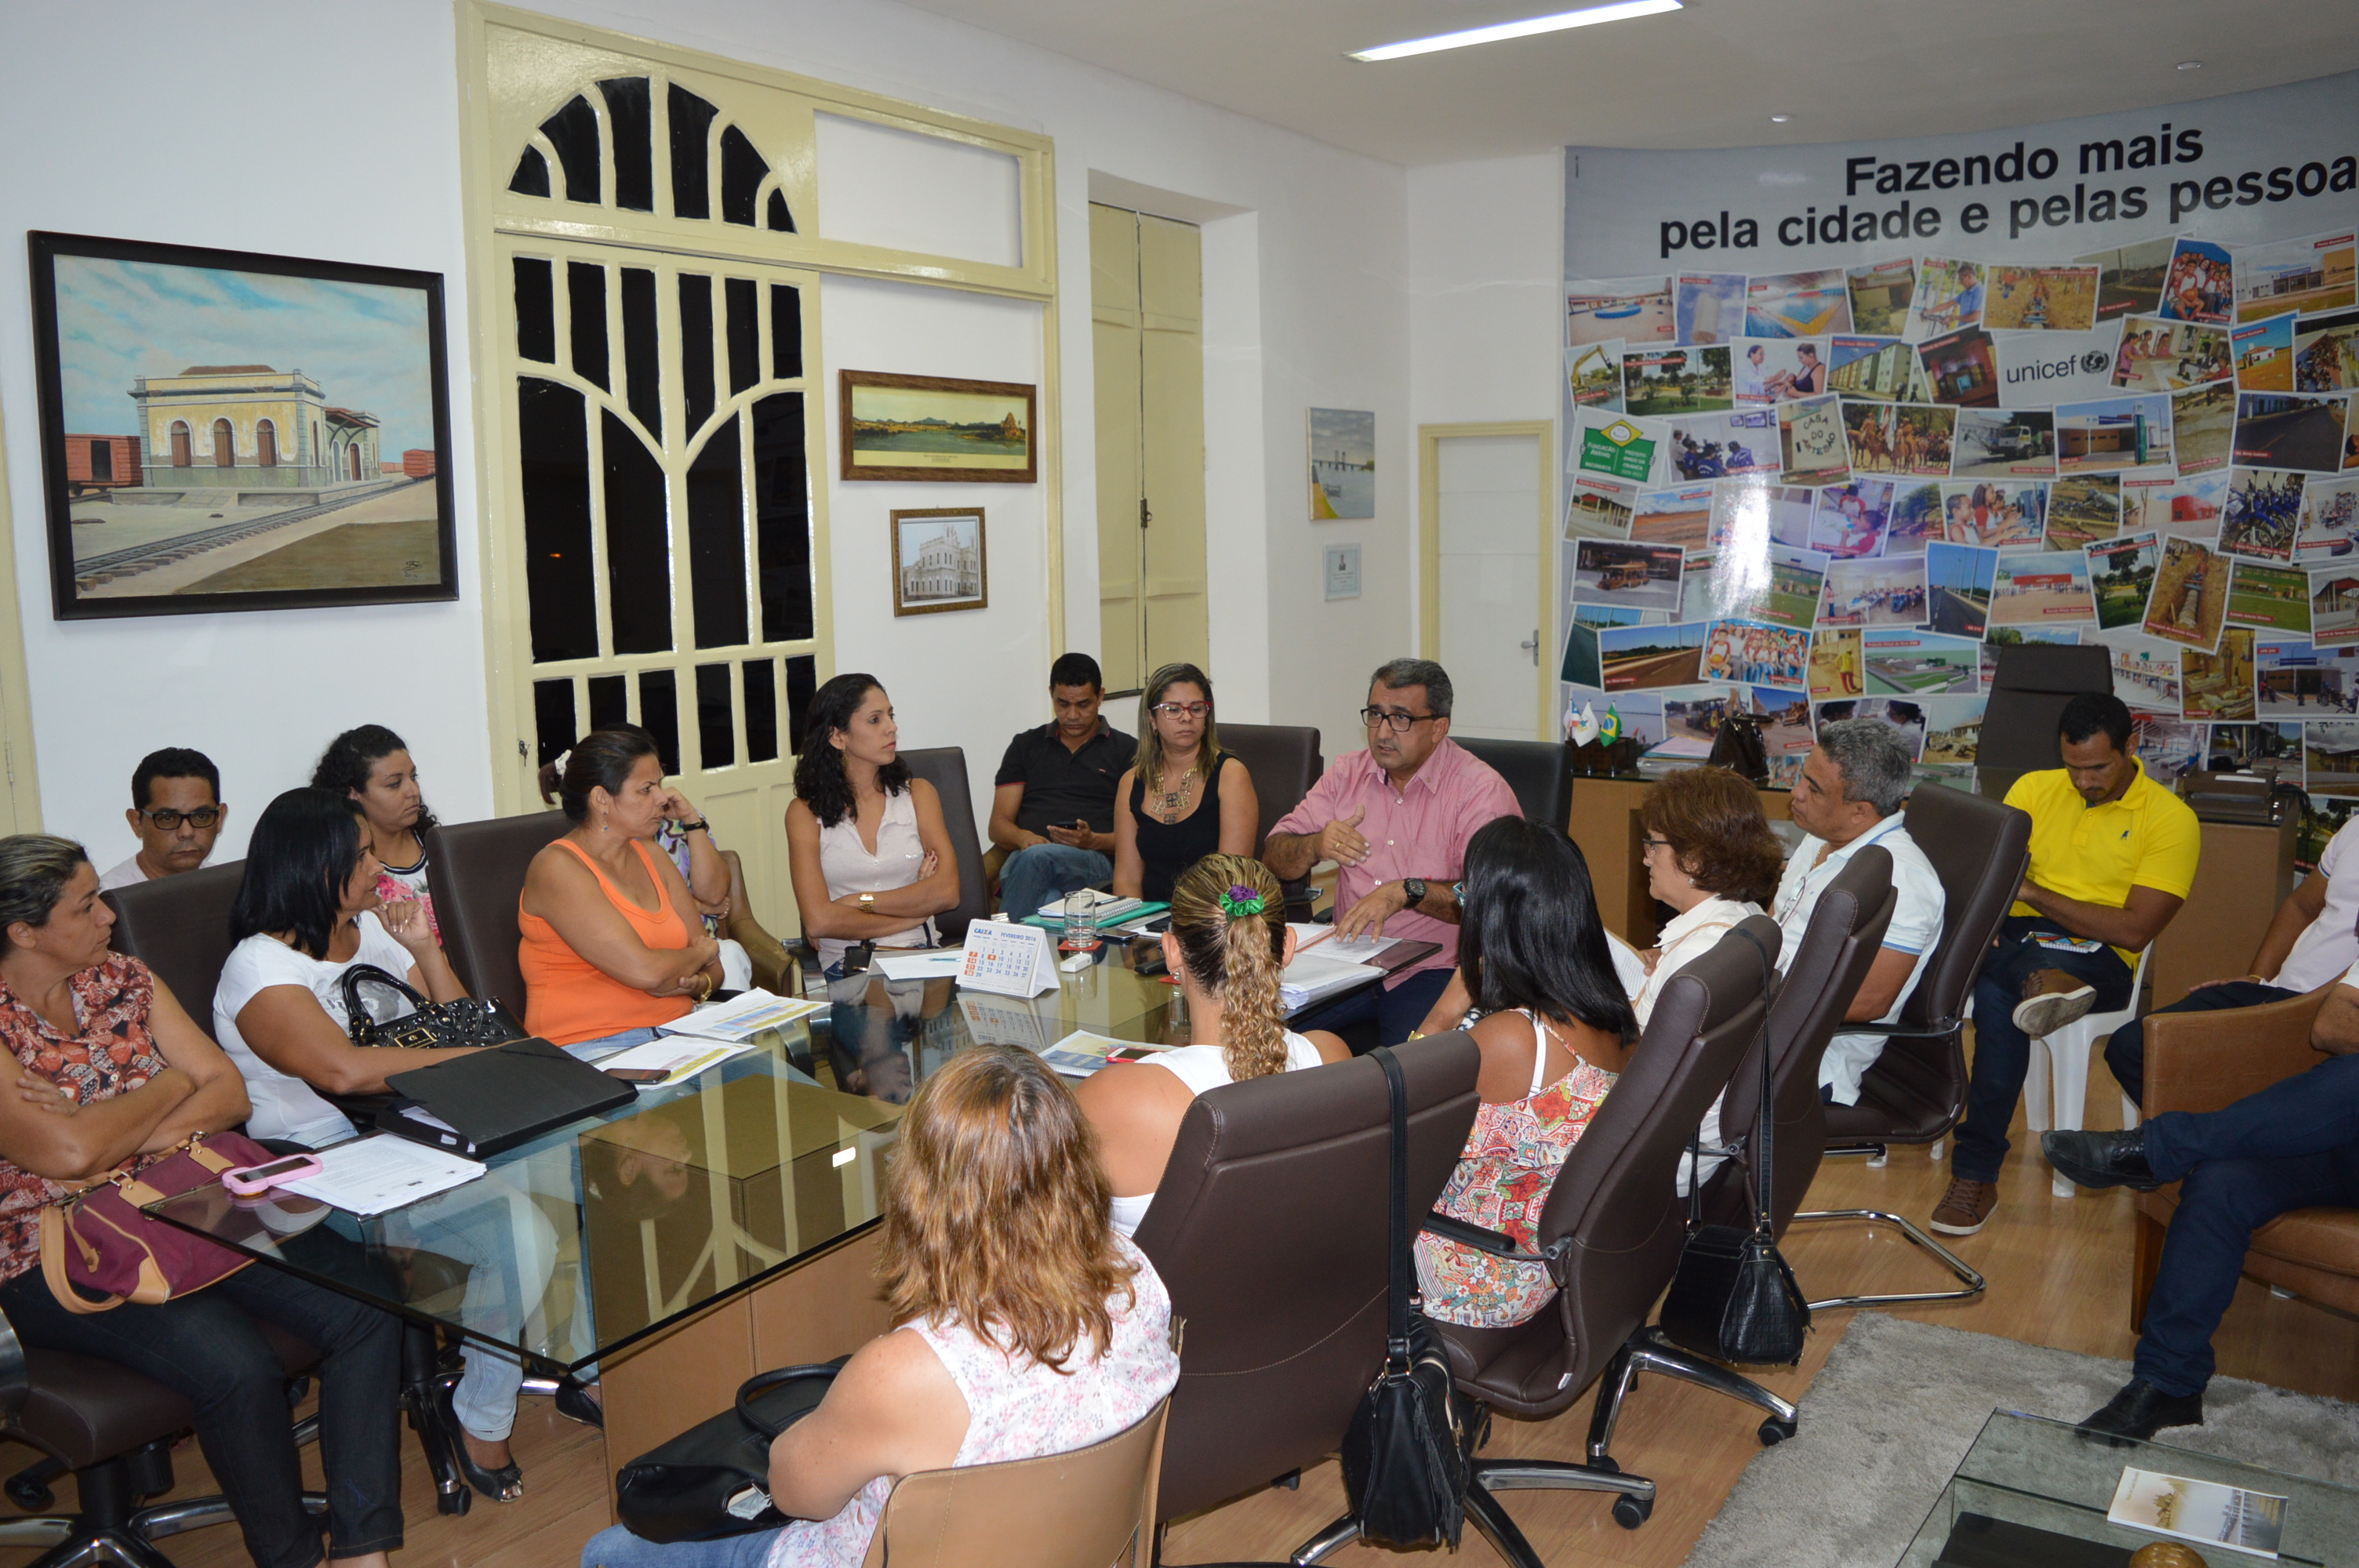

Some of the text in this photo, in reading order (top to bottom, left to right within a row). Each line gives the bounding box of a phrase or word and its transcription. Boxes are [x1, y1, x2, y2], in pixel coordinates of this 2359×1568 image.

[1846, 122, 2204, 196] Fazendo mais
[1661, 155, 2357, 259] pela cidade e pelas pessoa
[2007, 354, 2077, 383] unicef
